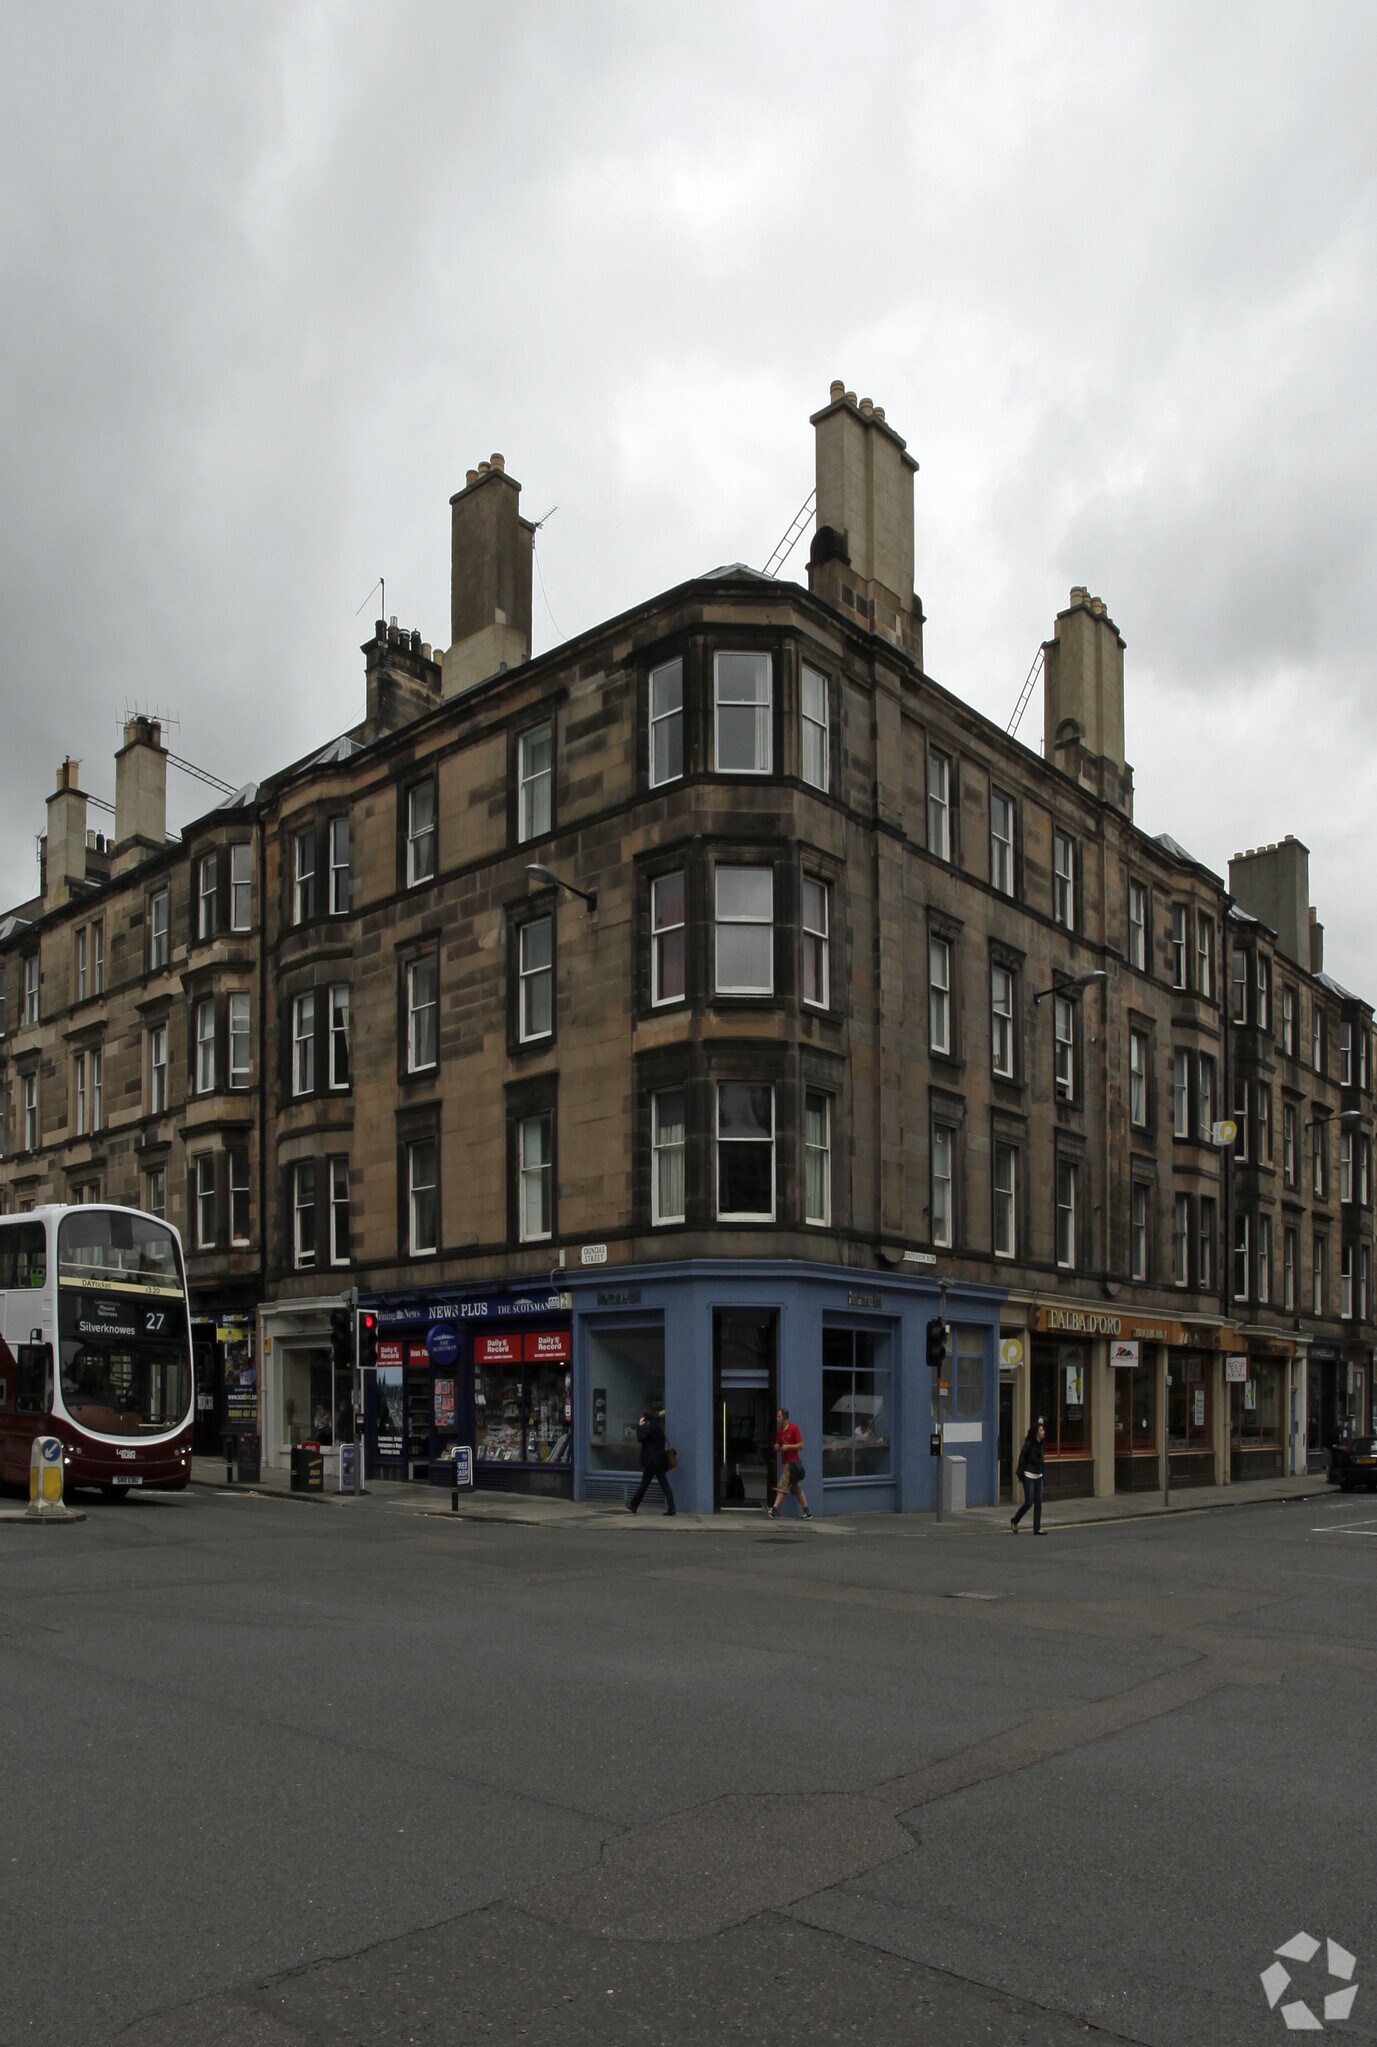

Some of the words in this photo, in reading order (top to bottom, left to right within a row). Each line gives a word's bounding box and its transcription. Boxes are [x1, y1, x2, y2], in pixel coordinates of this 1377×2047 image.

[583, 1246, 605, 1255] DUNDAS
[584, 1254, 604, 1263] STREET
[904, 1252, 926, 1261] ENDERSON
[82, 1279, 111, 1288] DAYticket
[428, 1306, 459, 1319] NEWS
[461, 1302, 488, 1317] PLUS
[497, 1305, 511, 1315] THE
[512, 1299, 550, 1313] SCOTSMAN
[402, 1308, 421, 1319] News
[145, 1312, 165, 1330] 27
[79, 1320, 136, 1335] Silverknowes
[1088, 1316, 1122, 1336] D'ORO
[487, 1339, 503, 1347] Daily
[538, 1336, 555, 1345] Daily
[380, 1346, 395, 1354] Daily
[487, 1345, 509, 1353] Record
[538, 1343, 562, 1351] Record
[116, 1448, 136, 1456] Lothian
